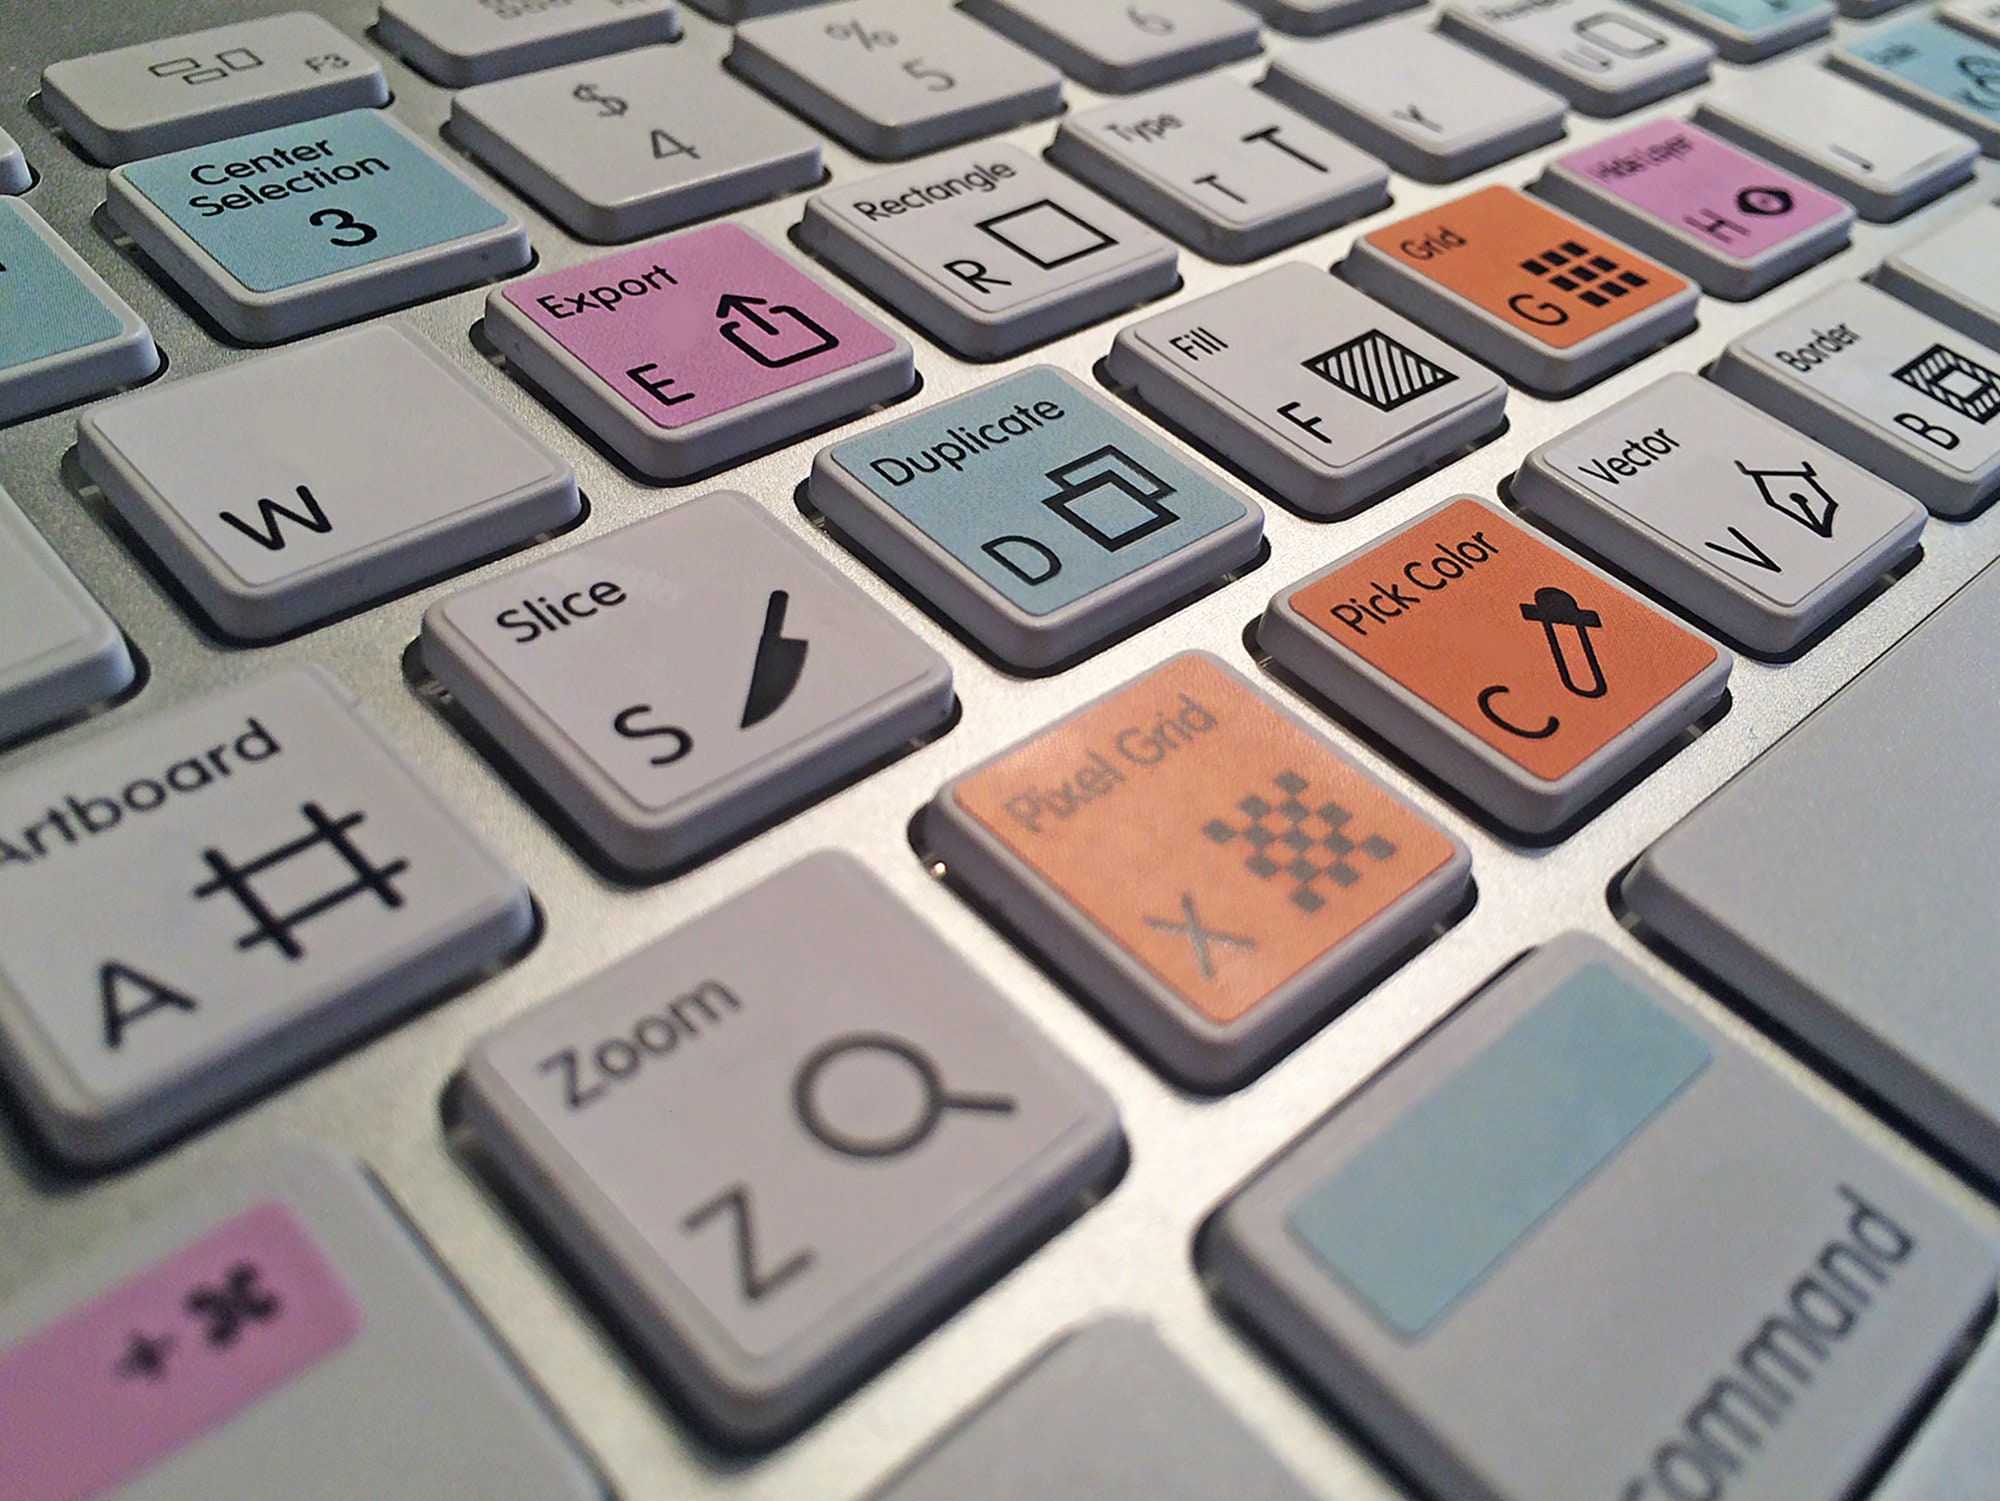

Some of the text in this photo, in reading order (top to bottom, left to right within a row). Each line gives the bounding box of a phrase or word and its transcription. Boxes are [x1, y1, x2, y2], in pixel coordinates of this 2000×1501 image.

[824, 19, 900, 53] %
[305, 53, 350, 74] F3
[901, 57, 958, 94] 5
[573, 83, 628, 119] $
[1391, 103, 1445, 134] Y
[650, 129, 702, 161] 4
[1104, 111, 1184, 144] Type
[188, 156, 391, 218] Selection
[189, 139, 335, 187] Center
[852, 158, 1018, 223] Rectangle
[1193, 173, 1249, 206] T
[307, 206, 379, 248] 3
[1400, 225, 1468, 262] Grid
[1682, 207, 1752, 245] H
[535, 263, 680, 322] Export
[943, 258, 1013, 295] R
[1508, 292, 1570, 328] G
[1168, 325, 1229, 363] Fill
[1775, 320, 1862, 373] Border
[625, 361, 697, 408] E
[868, 399, 1066, 488] Duplicate
[1276, 401, 1334, 445] F
[1892, 411, 1961, 451] B
[1578, 427, 1681, 487] Vector
[218, 483, 334, 552] W
[980, 534, 1063, 587] D
[1704, 525, 1783, 574] V
[1329, 530, 1499, 637] Pick Color
[495, 579, 628, 644] Slice
[612, 702, 695, 767] S
[1476, 684, 1560, 740] C
[1003, 692, 1219, 834] Pixel Grid
[1141, 891, 1256, 982] X
[99, 957, 197, 1050] A
[537, 976, 744, 1112] Zoom
[678, 1178, 819, 1305] Z
